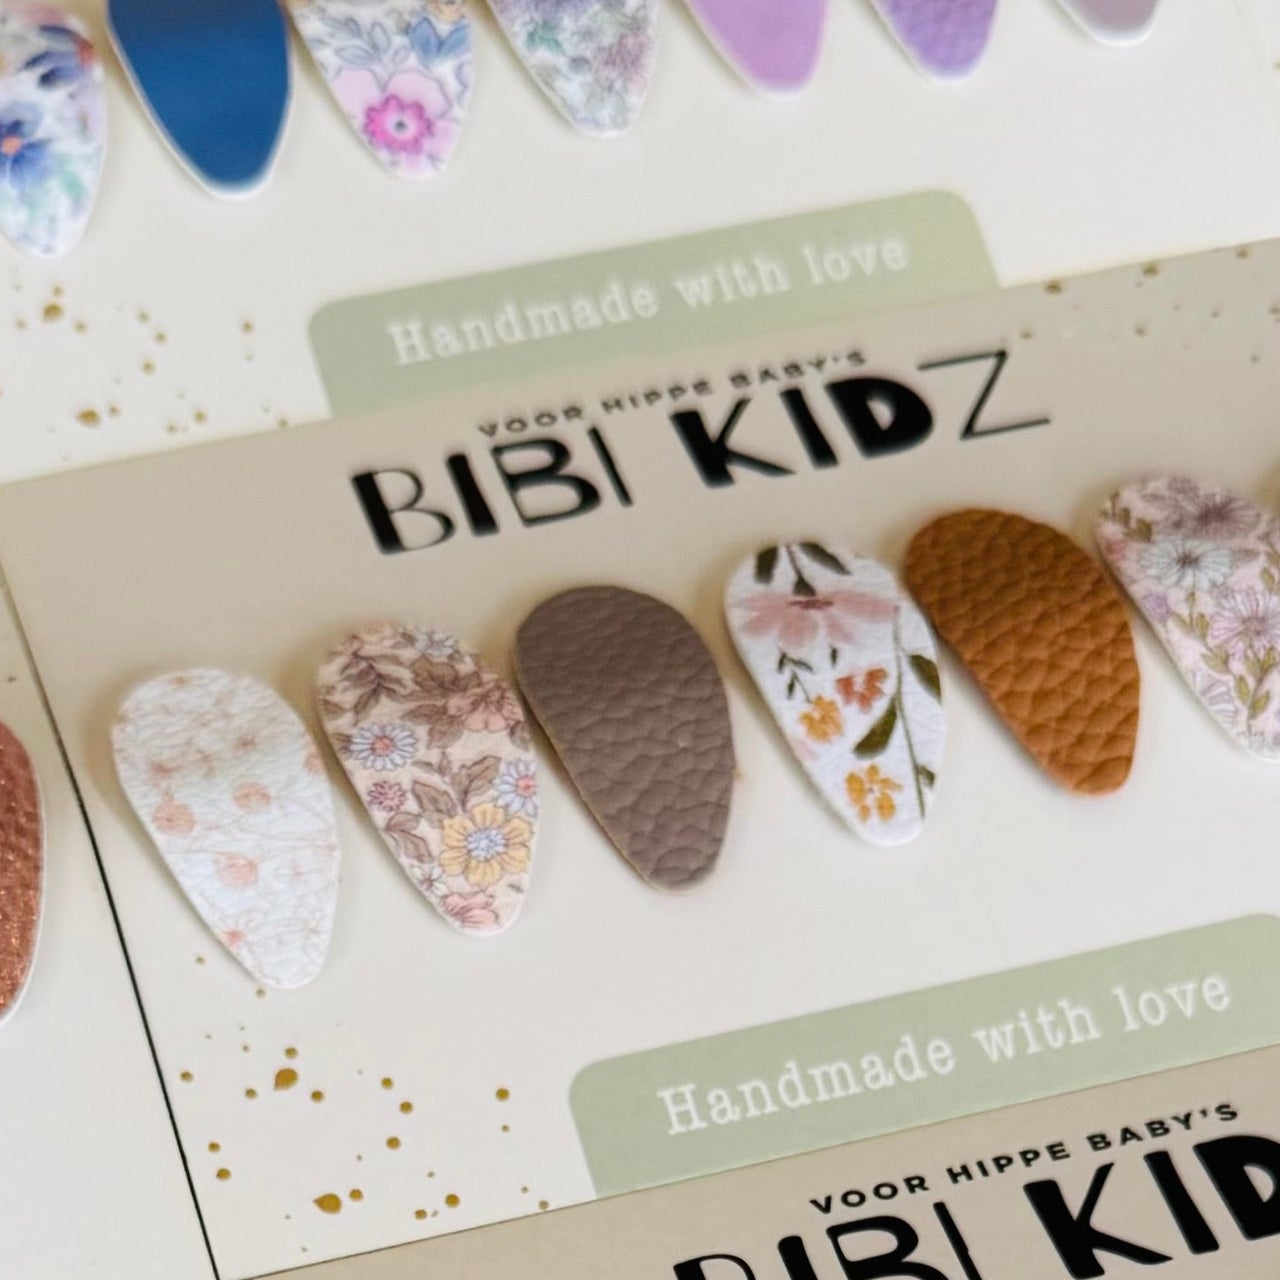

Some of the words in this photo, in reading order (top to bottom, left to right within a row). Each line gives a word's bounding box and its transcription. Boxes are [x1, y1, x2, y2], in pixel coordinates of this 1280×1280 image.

[386, 277, 659, 367] Handmade
[674, 254, 790, 309] with
[802, 236, 908, 285] love
[351, 426, 633, 555] BIBI
[669, 348, 1050, 488] KIDZ
[477, 404, 584, 438] VOOR
[601, 378, 714, 415] HIPPE
[730, 350, 866, 388] BABY'S
[658, 1034, 957, 1135] Handmade
[973, 998, 1102, 1064] with
[1111, 972, 1232, 1032] love
[810, 1174, 929, 1215] VOOR
[947, 1141, 1071, 1185] HIPPE
[1087, 1102, 1240, 1152] BABY'S
